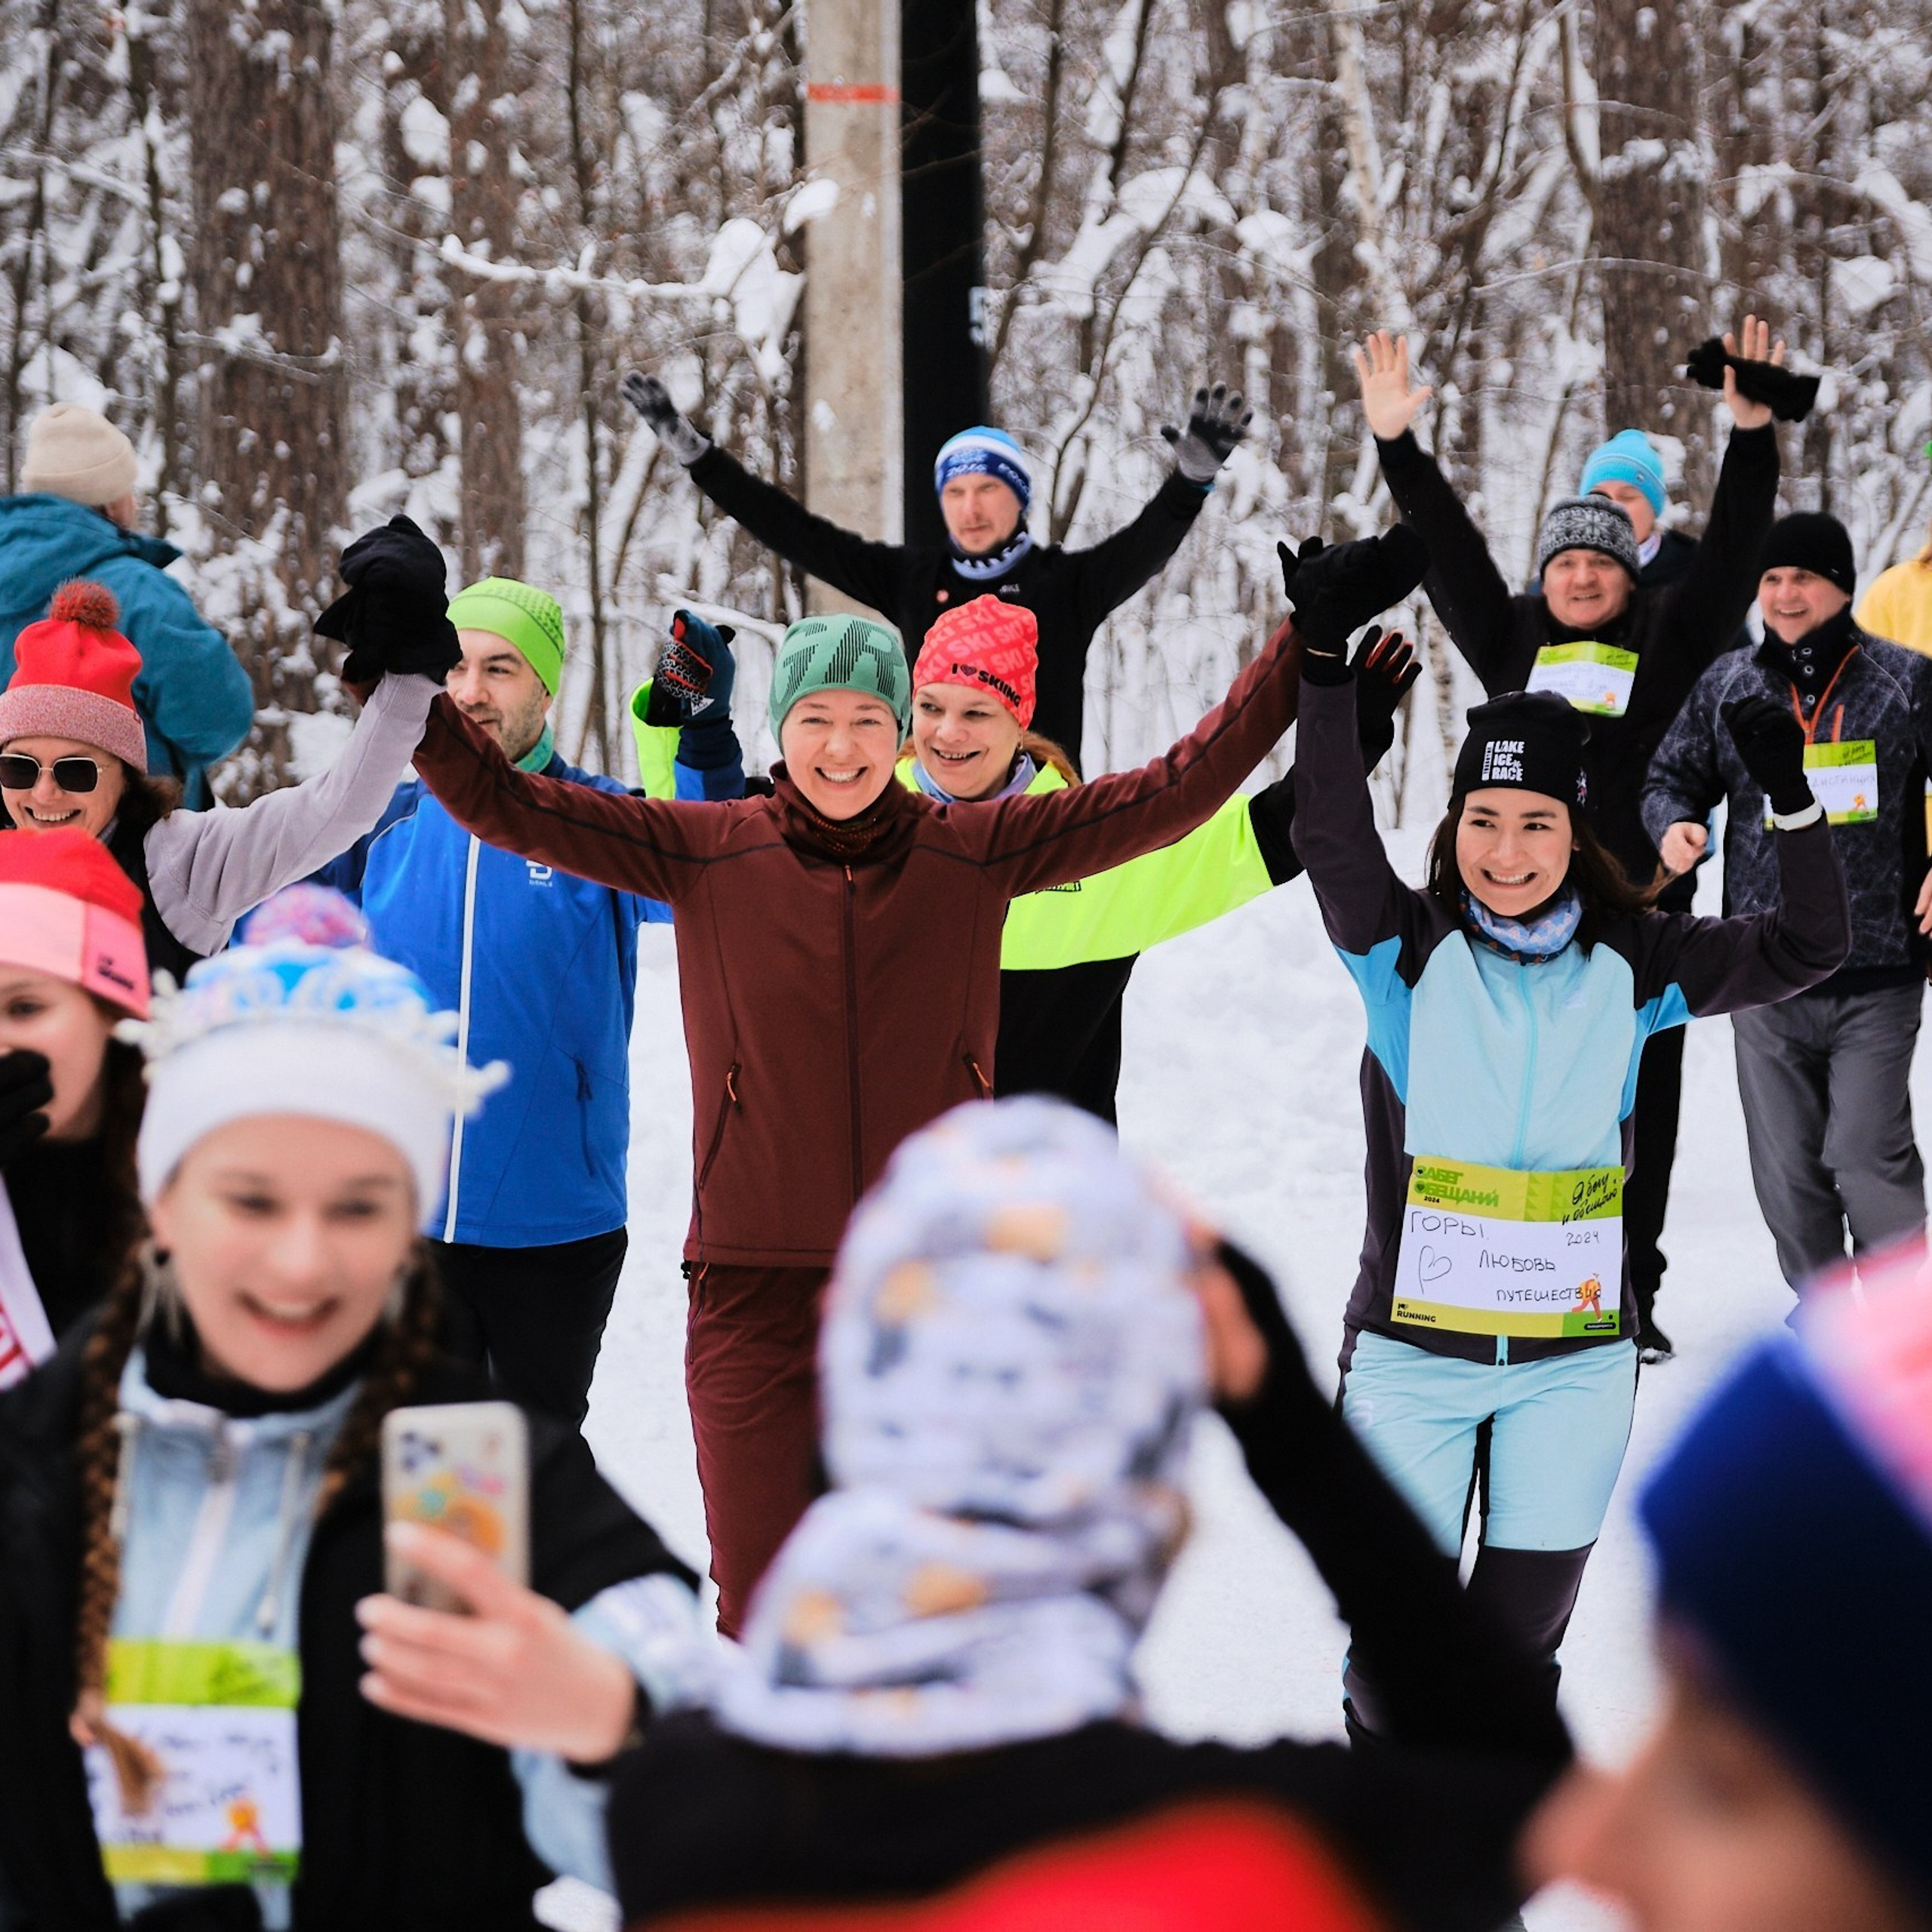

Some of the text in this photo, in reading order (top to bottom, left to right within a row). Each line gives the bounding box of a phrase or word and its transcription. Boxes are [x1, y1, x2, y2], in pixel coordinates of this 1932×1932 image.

[946, 630, 996, 659] SKI
[990, 648, 1025, 675] SKI
[952, 663, 1021, 707] I SKIING
[1494, 740, 1524, 754] LAKE
[1494, 753, 1513, 766] ICE
[1491, 767, 1523, 782] RACE
[1423, 1195, 1440, 1204] 2024
[1566, 1231, 1599, 1246] 2024
[1479, 1249, 1556, 1272] ЛЮБОВЬ
[1396, 1310, 1436, 1322] RUNNING
